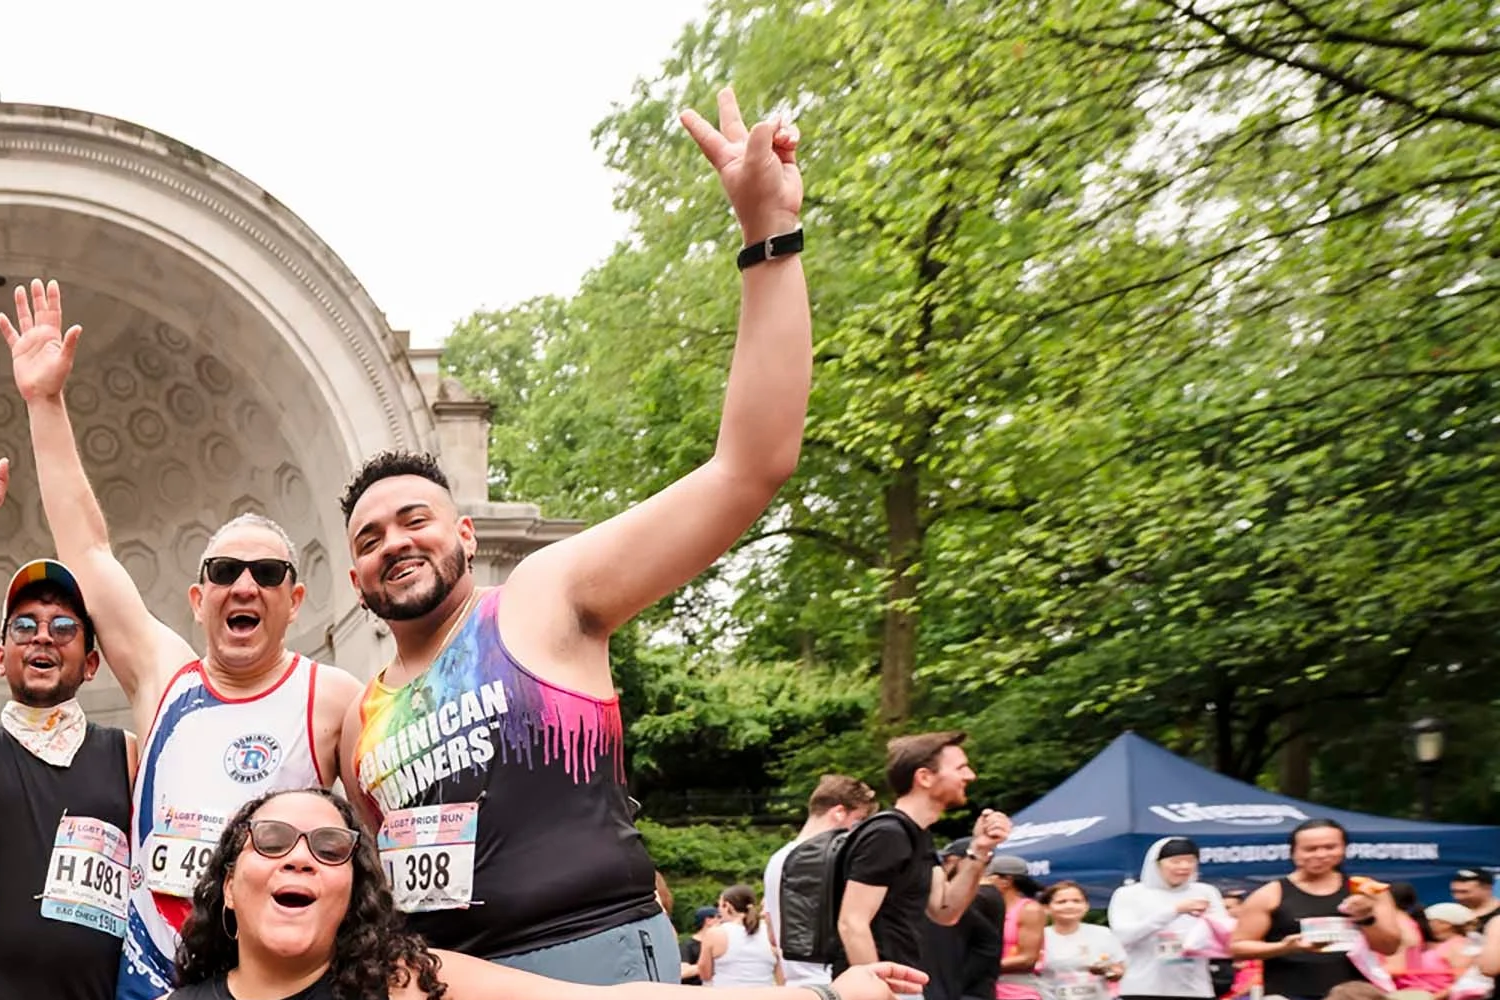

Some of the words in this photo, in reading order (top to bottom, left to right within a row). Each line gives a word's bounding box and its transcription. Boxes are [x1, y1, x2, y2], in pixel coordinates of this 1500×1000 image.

[233, 735, 279, 751] DOMINICAN
[175, 811, 196, 821] LGBT
[197, 814, 225, 825] PRIDE
[410, 813, 438, 827] PRIDE
[441, 812, 464, 824] RUN
[152, 845, 169, 872] G
[180, 846, 214, 879] 49
[1198, 844, 1291, 864] PROBIOT
[56, 855, 76, 882] H
[81, 856, 122, 900] 1981
[405, 852, 451, 891] 398
[75, 910, 98, 922] CHECK
